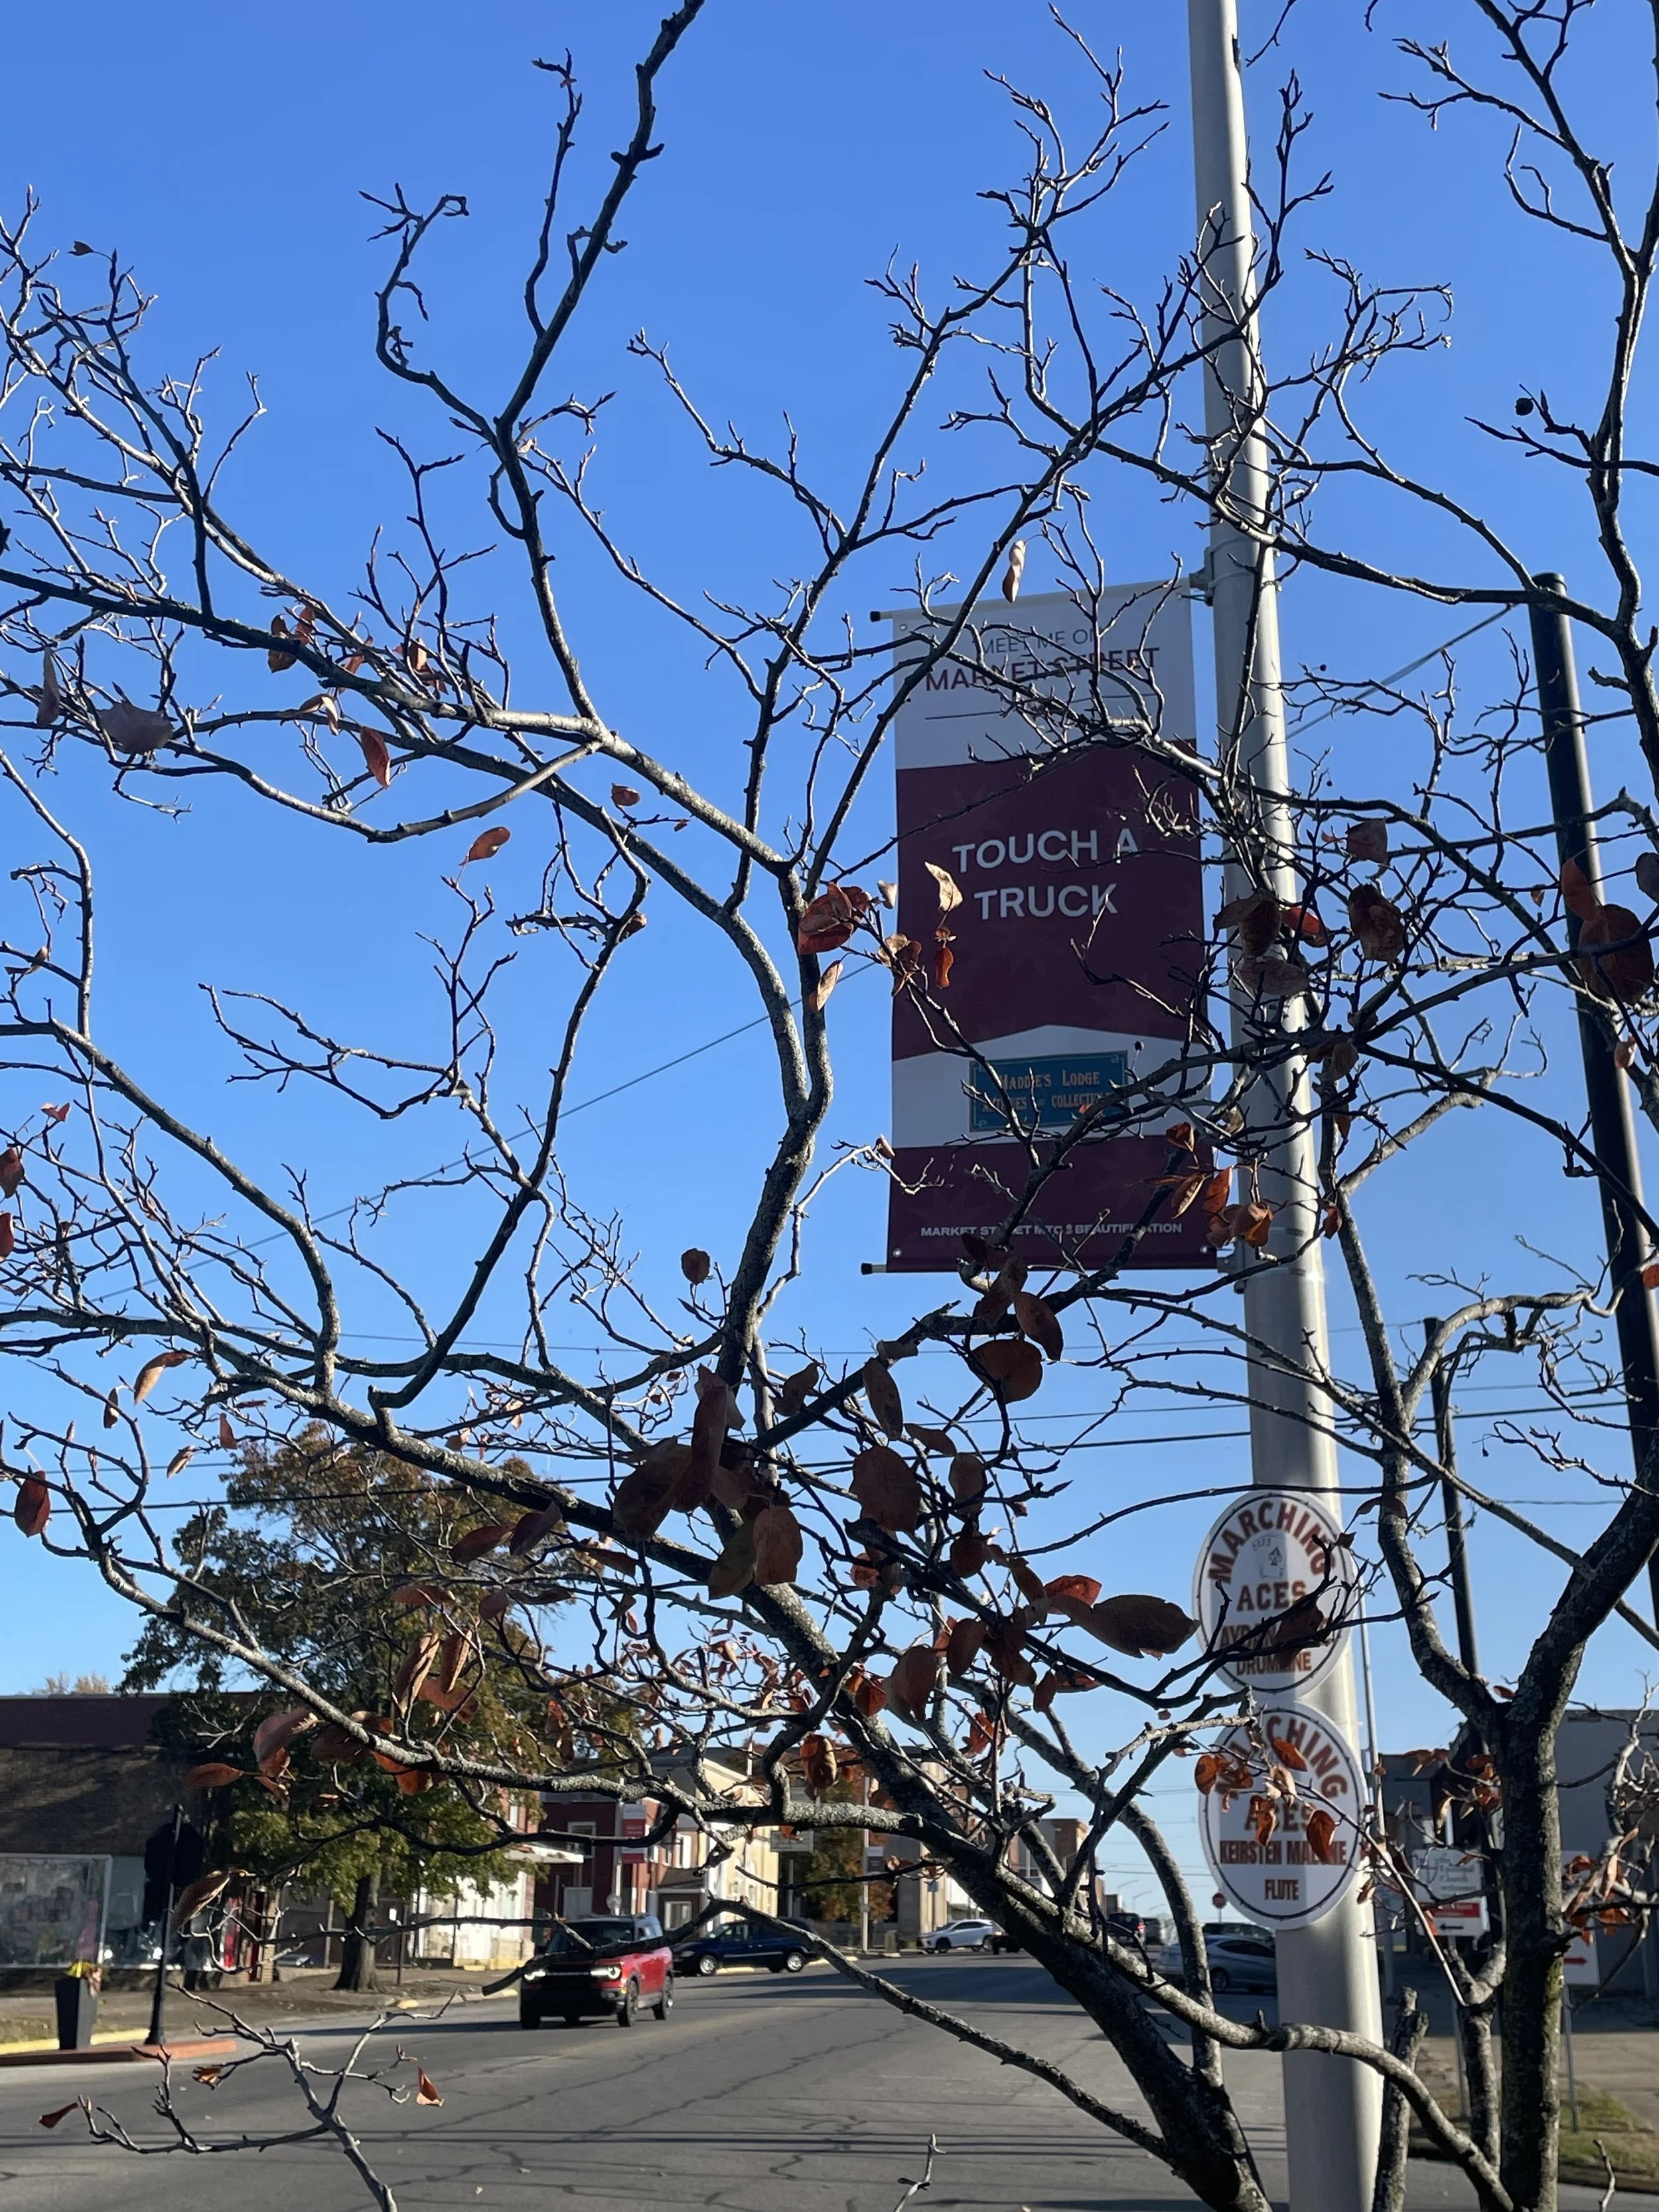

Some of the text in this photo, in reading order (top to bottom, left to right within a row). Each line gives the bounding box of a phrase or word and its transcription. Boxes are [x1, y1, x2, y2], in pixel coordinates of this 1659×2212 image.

[983, 636, 1030, 655] MEET
[1037, 630, 1066, 648] ME
[952, 828, 1141, 873] TOUCH A
[974, 883, 1118, 921] TRUCK
[997, 1073, 1052, 1092] ADDE'S
[920, 1226, 977, 1236] MARKET
[980, 1225, 1032, 1236] STET
[1208, 1501, 1336, 1585] MARCHING
[1236, 1580, 1307, 1613] ACES
[1236, 1651, 1312, 1676] DRUMNE
[1214, 1715, 1348, 1801] CHING
[1244, 1797, 1315, 1832] AES
[1287, 1840, 1347, 1866] MALNE
[1264, 1879, 1299, 1901] FLUTE
